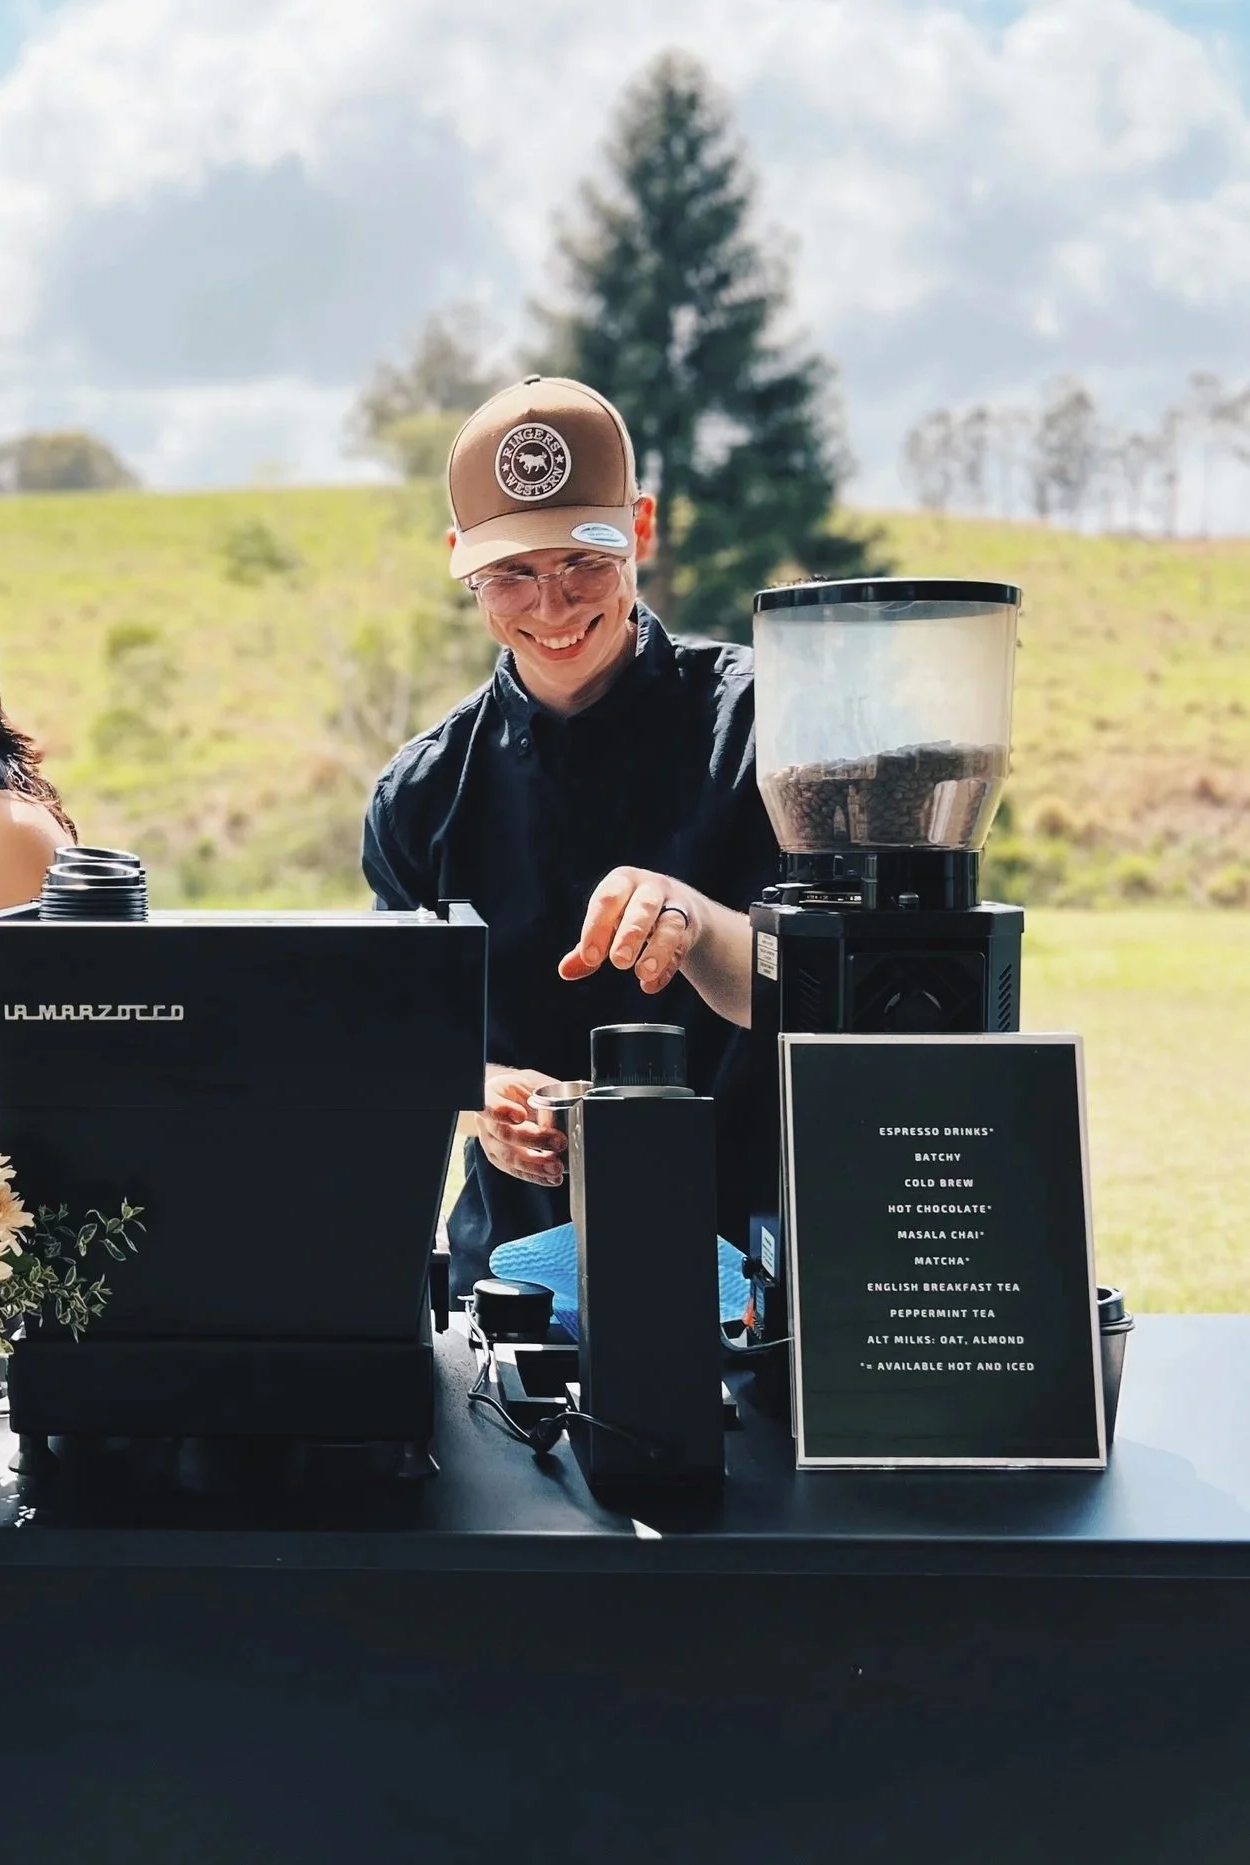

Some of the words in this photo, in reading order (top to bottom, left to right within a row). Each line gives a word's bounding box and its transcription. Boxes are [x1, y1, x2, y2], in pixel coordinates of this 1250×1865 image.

[502, 428, 561, 459] RINGERS
[505, 466, 564, 495] WESTERN
[3, 1004, 28, 1021] LA
[38, 1004, 185, 1021] MARZOCCO
[879, 1127, 940, 1136] ESPRESSO
[914, 1152, 961, 1162] BATCHY
[904, 1178, 936, 1188] COLD
[939, 1178, 974, 1188] BREW
[887, 1204, 912, 1214] HOT
[897, 1230, 947, 1240] MASALA
[867, 1282, 919, 1292] ENGLISH
[922, 1282, 993, 1292] BREAKFAST
[996, 1282, 1021, 1292] TEA
[889, 1308, 968, 1318] PEPPERMINT
[971, 1308, 996, 1318] TEA
[866, 1335, 890, 1345] ALT
[894, 1335, 936, 1345] MILKS:
[939, 1335, 968, 1345] OAT,
[972, 1335, 1025, 1345] ALMOND
[877, 1361, 944, 1371] AVAILABLE
[947, 1361, 972, 1371] HOT
[976, 1361, 1002, 1372] AND
[1006, 1361, 1035, 1372] ICED
